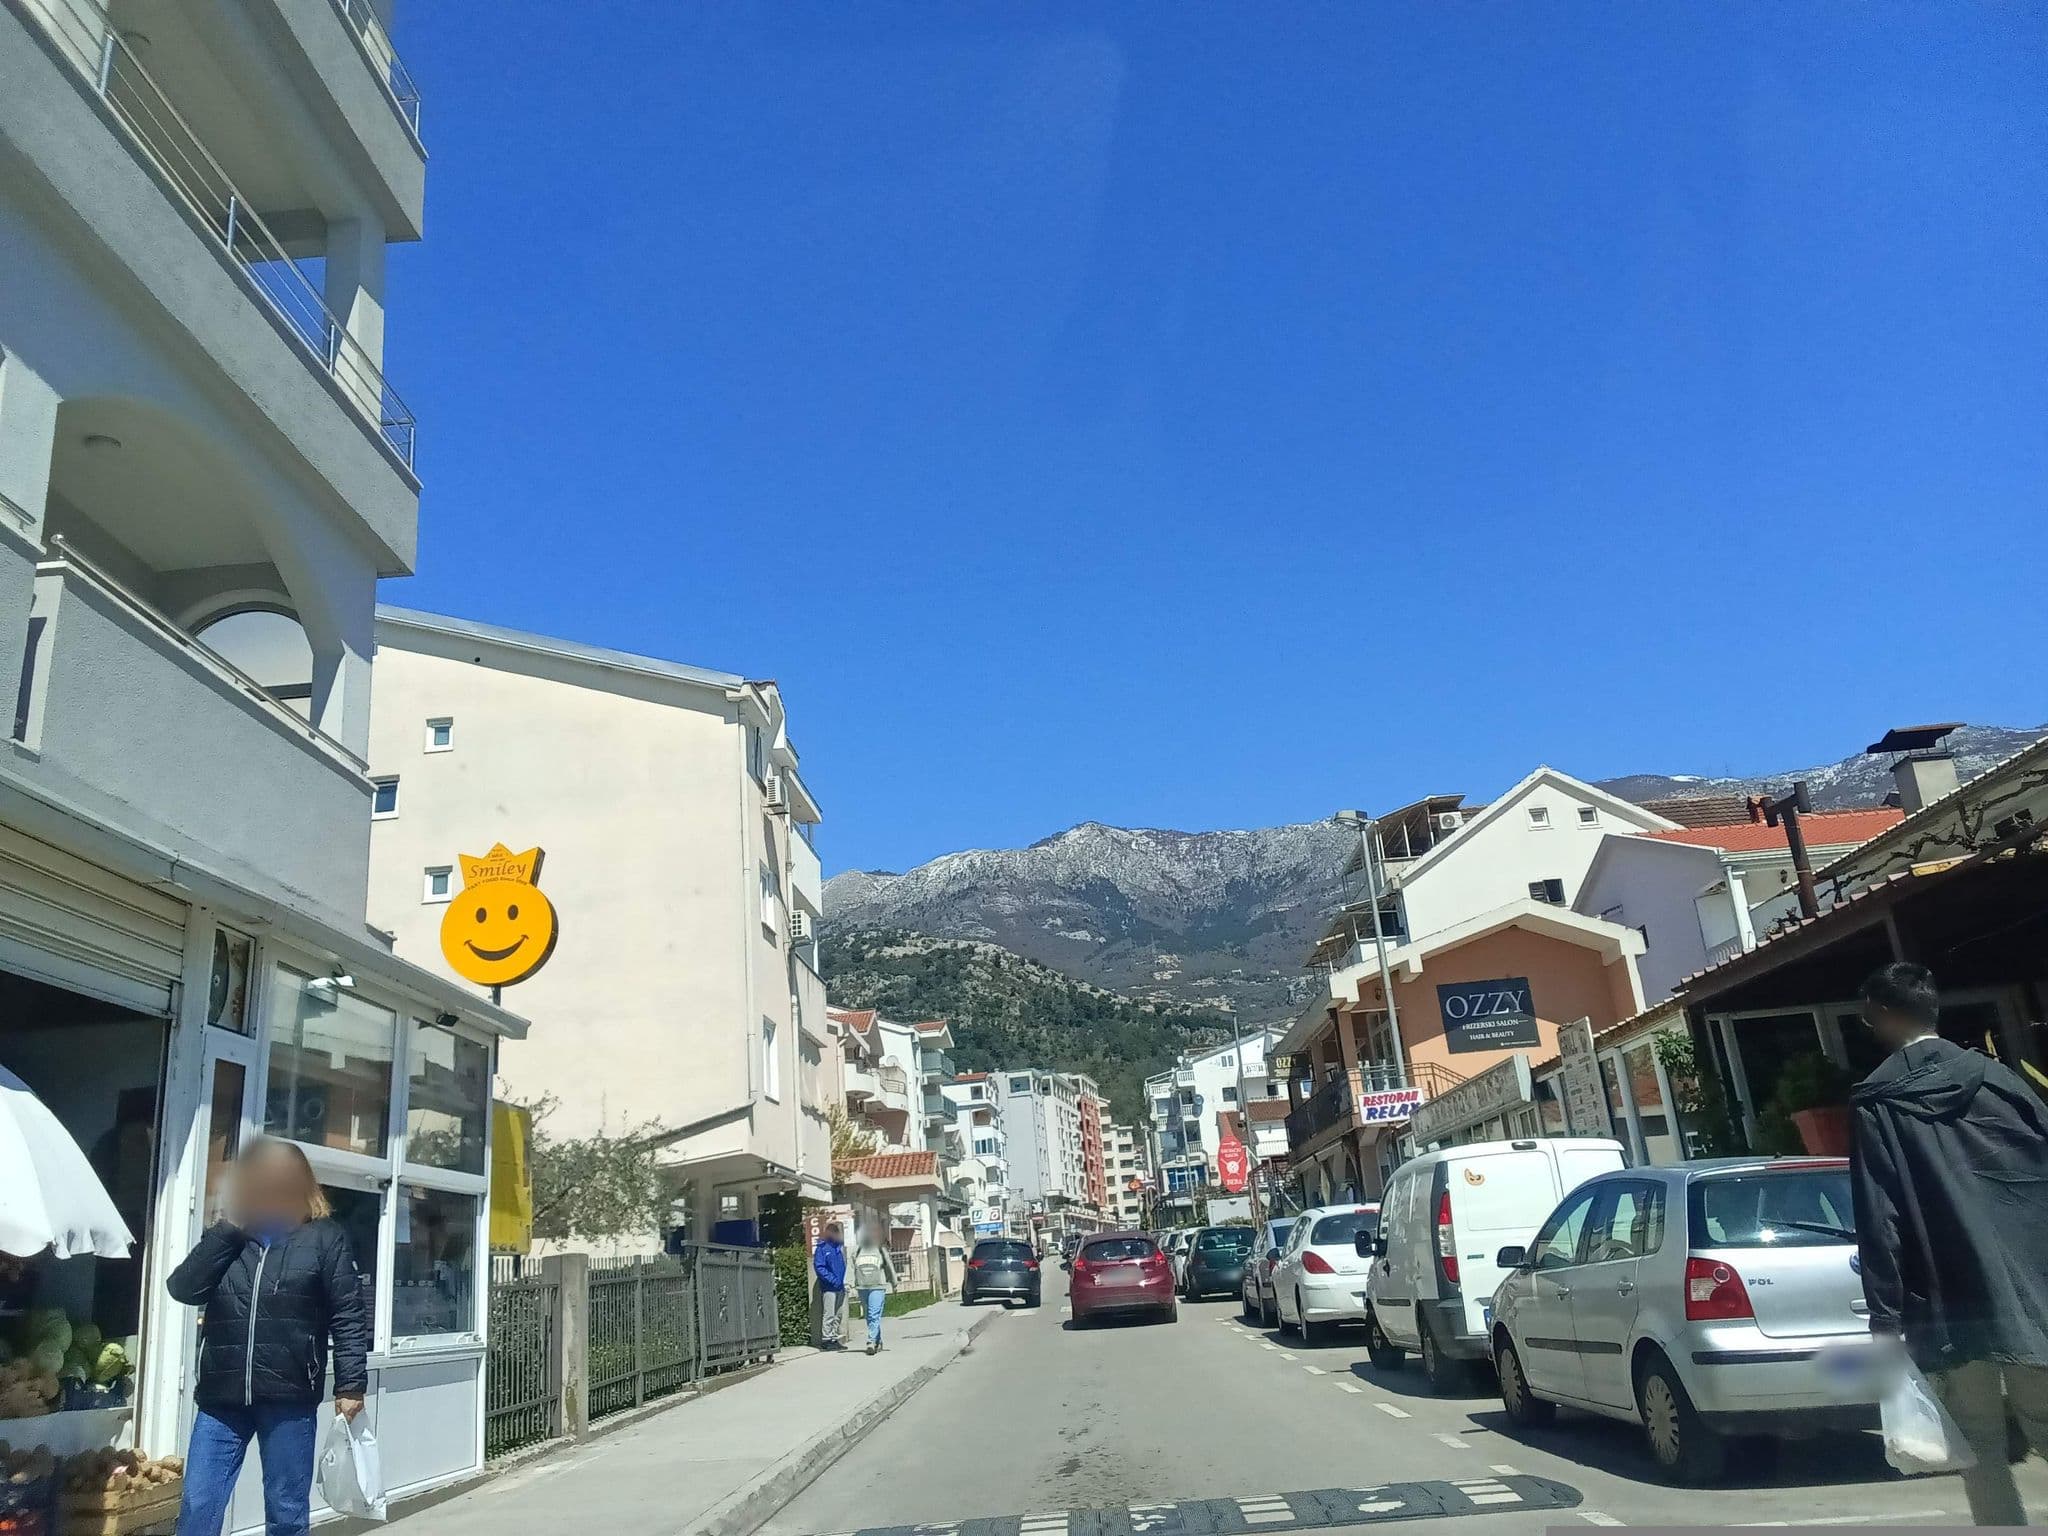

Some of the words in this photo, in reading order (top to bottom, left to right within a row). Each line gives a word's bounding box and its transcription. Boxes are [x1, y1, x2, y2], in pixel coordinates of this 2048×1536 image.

[469, 860, 527, 879] Smiley
[1445, 990, 1524, 1019] OZZY
[1363, 1091, 1418, 1107] RESTORAN
